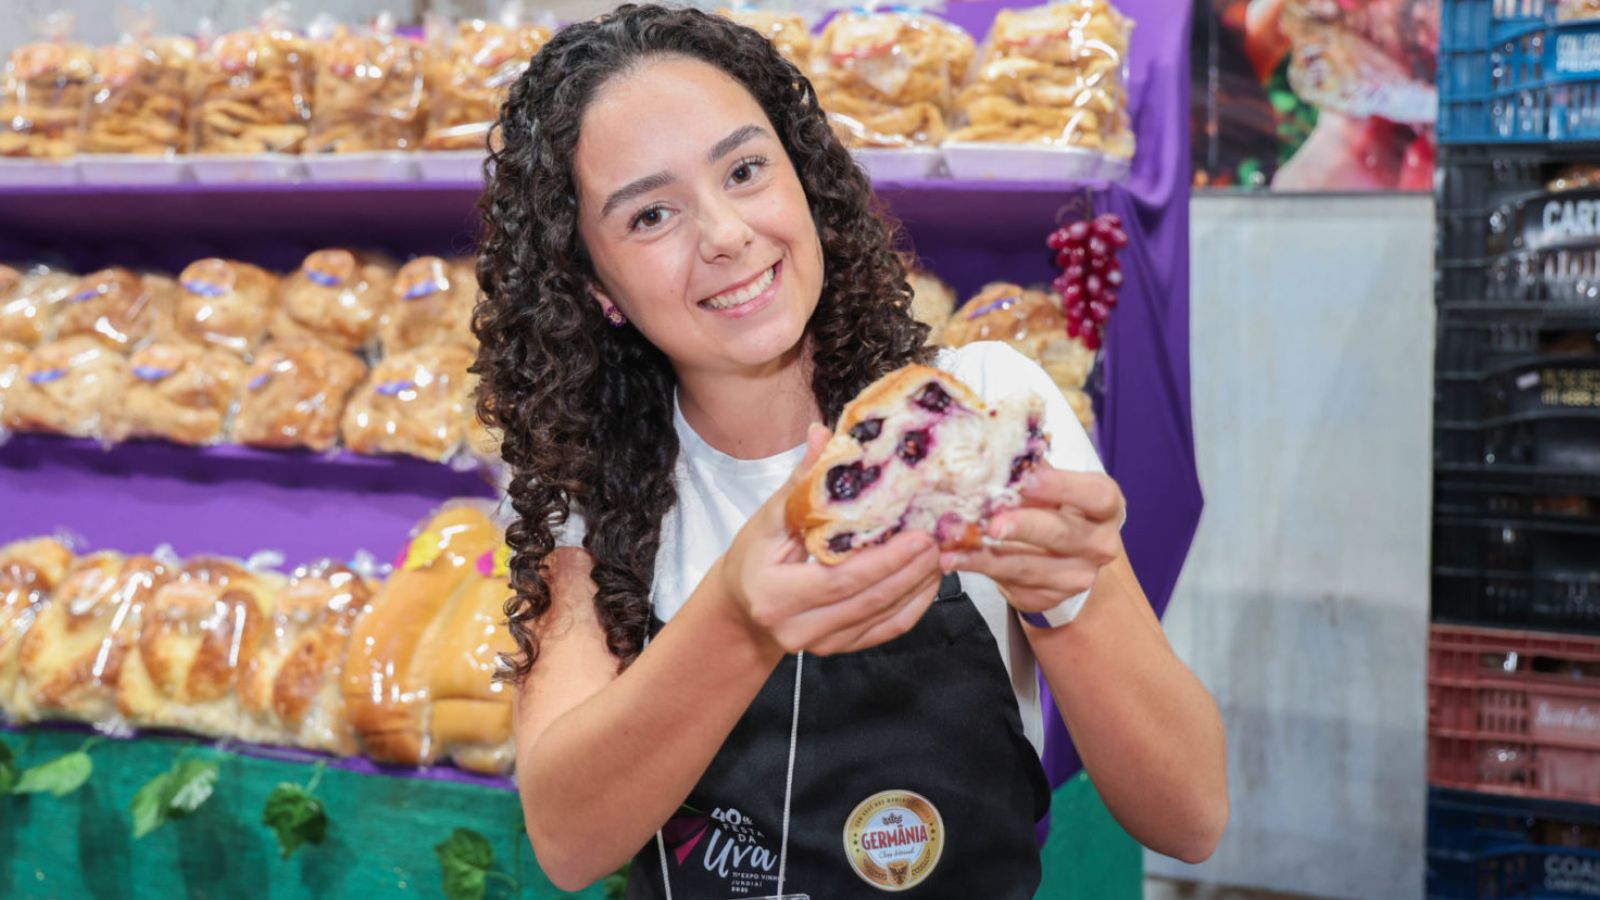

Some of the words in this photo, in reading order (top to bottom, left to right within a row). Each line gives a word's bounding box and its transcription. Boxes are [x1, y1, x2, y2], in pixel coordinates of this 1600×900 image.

[722, 823, 766, 839] FESTA
[738, 834, 756, 844] DA
[861, 824, 928, 850] GERMÂNIA
[703, 828, 778, 878] Uva
